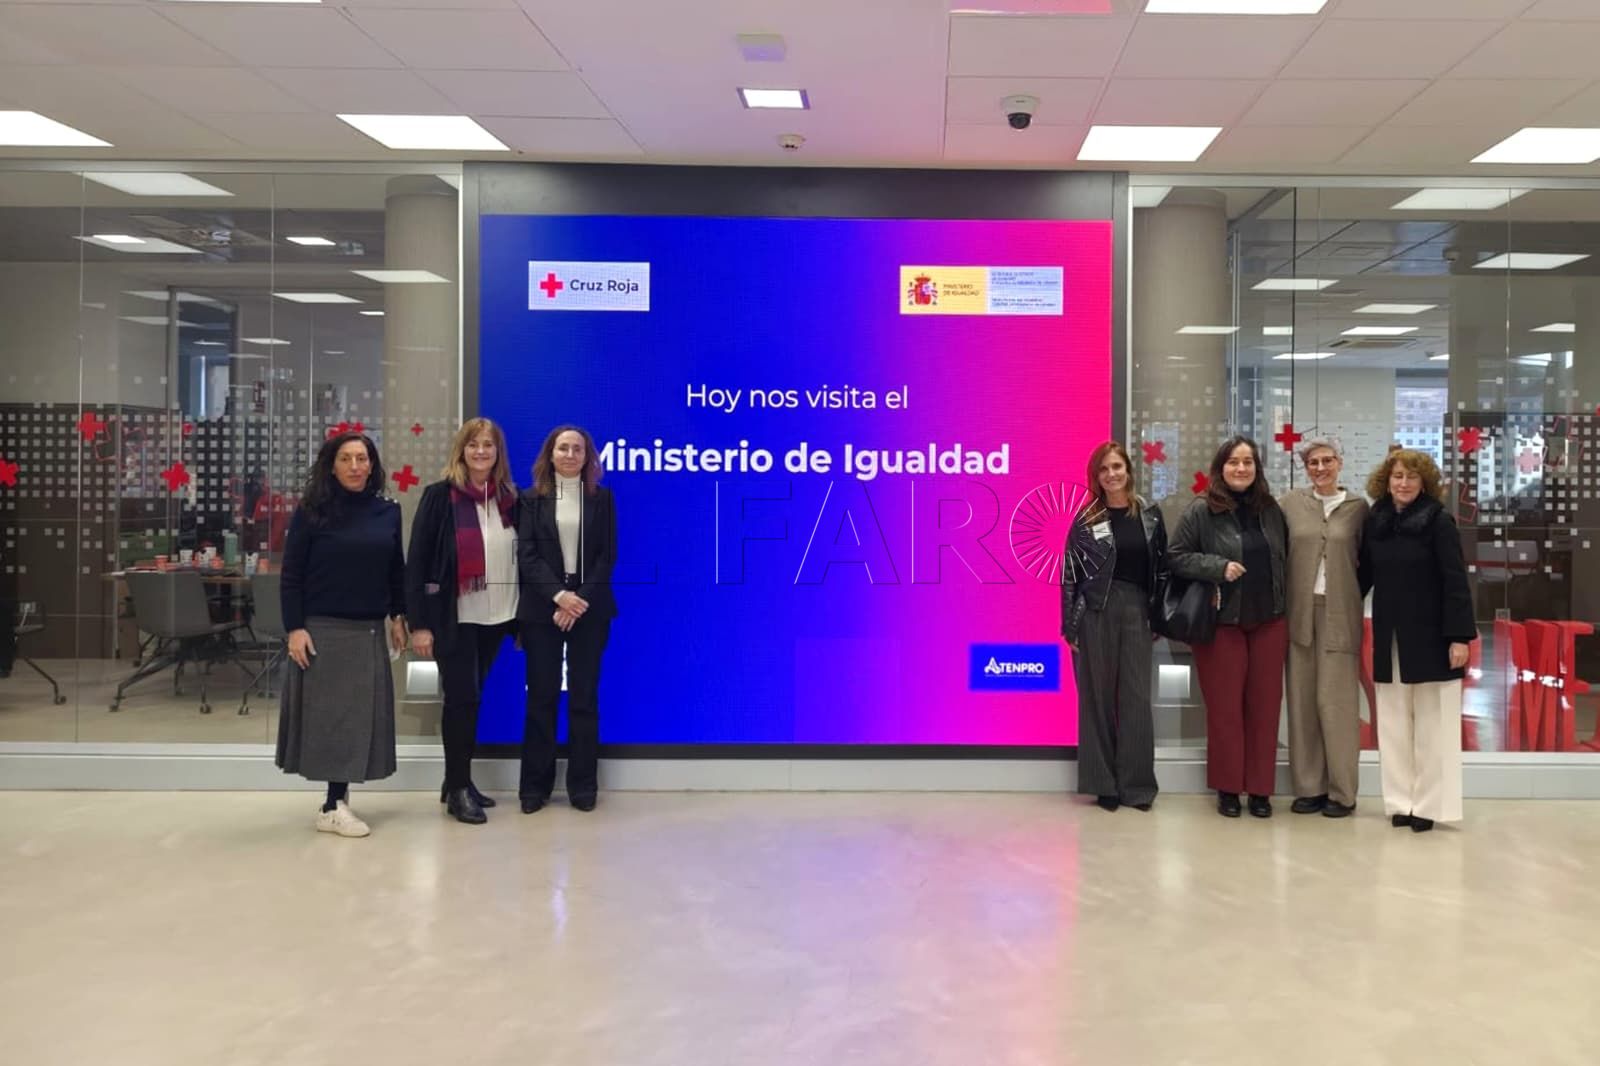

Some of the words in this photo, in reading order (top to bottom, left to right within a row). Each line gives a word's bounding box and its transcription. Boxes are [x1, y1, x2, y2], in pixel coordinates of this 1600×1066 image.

[569, 279, 603, 292] Cruz
[607, 278, 639, 295] Roja
[687, 384, 741, 413] Hoy
[750, 389, 799, 408] nos
[806, 385, 876, 409] visita
[885, 385, 908, 409] el
[784, 442, 832, 474] de
[844, 443, 1010, 481] Igualdad
[984, 657, 1045, 674] ATENPRO
